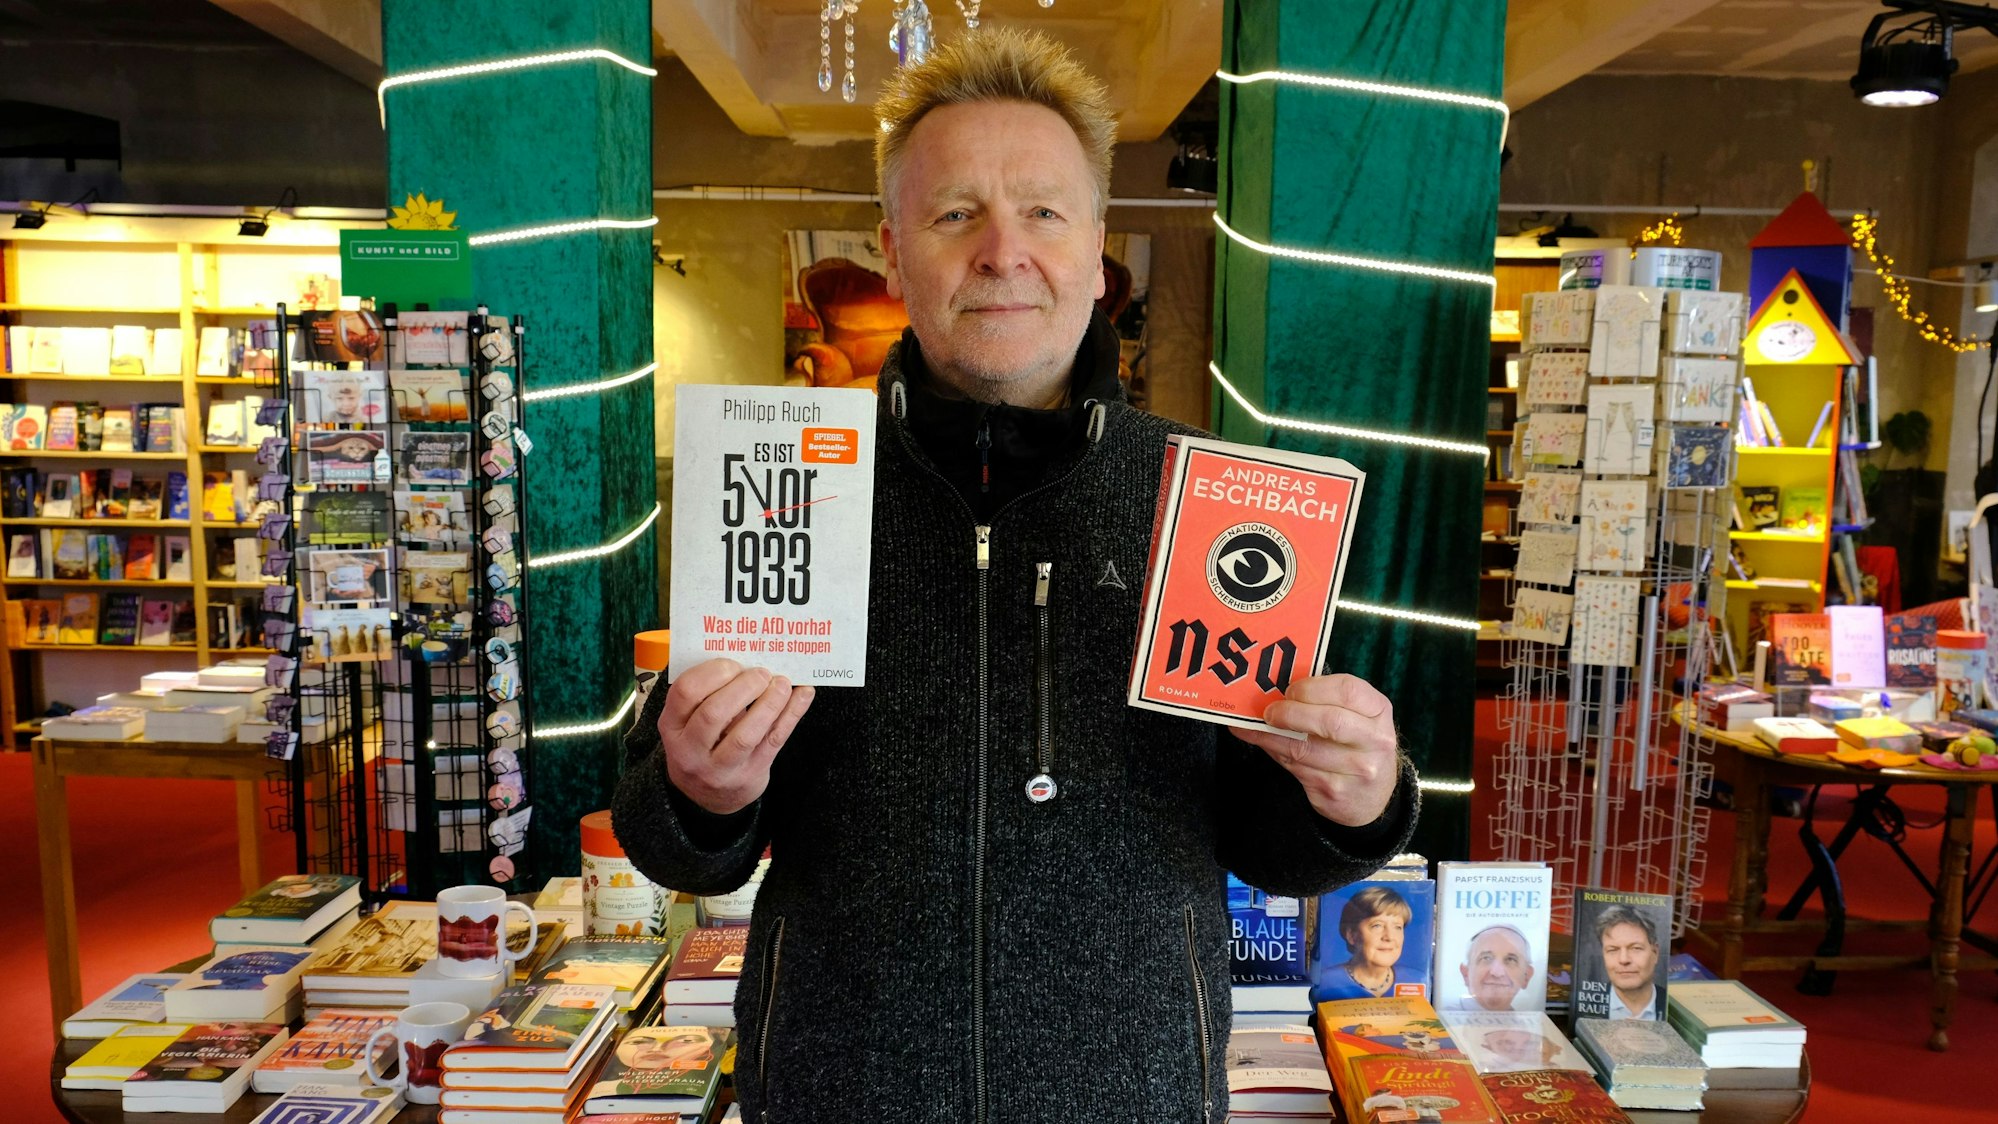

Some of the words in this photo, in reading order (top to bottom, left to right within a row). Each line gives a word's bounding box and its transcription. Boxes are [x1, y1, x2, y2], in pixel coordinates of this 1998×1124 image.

[398, 247, 419, 255] und
[425, 247, 451, 255] BILD
[723, 399, 776, 424] Philipp
[782, 401, 821, 423] Ruch
[813, 432, 846, 443] SPIEGEL
[754, 443, 770, 463] ES
[773, 444, 795, 463] IST
[808, 443, 851, 453] Bestseller-
[818, 451, 841, 460] Autor
[1221, 465, 1317, 496] ANDREAS
[722, 454, 745, 528] 5
[1193, 477, 1339, 523] ESCHBACH
[1226, 523, 1288, 549] NATIONALES
[721, 530, 811, 606] 1933
[1209, 576, 1284, 611] SICHERHEITS-AMT
[703, 615, 733, 635] Was
[737, 616, 758, 635] die
[761, 617, 785, 635] AfD
[787, 618, 832, 636] vorhat
[704, 637, 725, 652] und
[727, 637, 746, 652] wie
[748, 638, 766, 653] wir
[768, 638, 785, 653] sie
[787, 639, 831, 655] stoppen
[1782, 636, 1810, 649] TOO
[1165, 618, 1297, 696] nsa
[1887, 648, 1937, 666] ROSALINE
[812, 668, 854, 679] LUDWIG
[1158, 685, 1199, 699] ROMAN
[600, 901, 625, 911] Vintage
[627, 901, 649, 909] Puzzle
[1455, 889, 1542, 909] HOFFE
[1583, 892, 1622, 903] ROBERT
[1625, 896, 1667, 907] HABECK
[1232, 918, 1297, 939] BLAUE
[1227, 940, 1297, 961] TUNDE
[1582, 981, 1608, 992] DEN
[1578, 991, 1610, 1003] BACH
[1578, 1003, 1609, 1015] RAUF
[160, 1051, 251, 1059] VEGETARIERIN
[1276, 1069, 1310, 1077] Weg
[1375, 1066, 1452, 1084] Lindt
